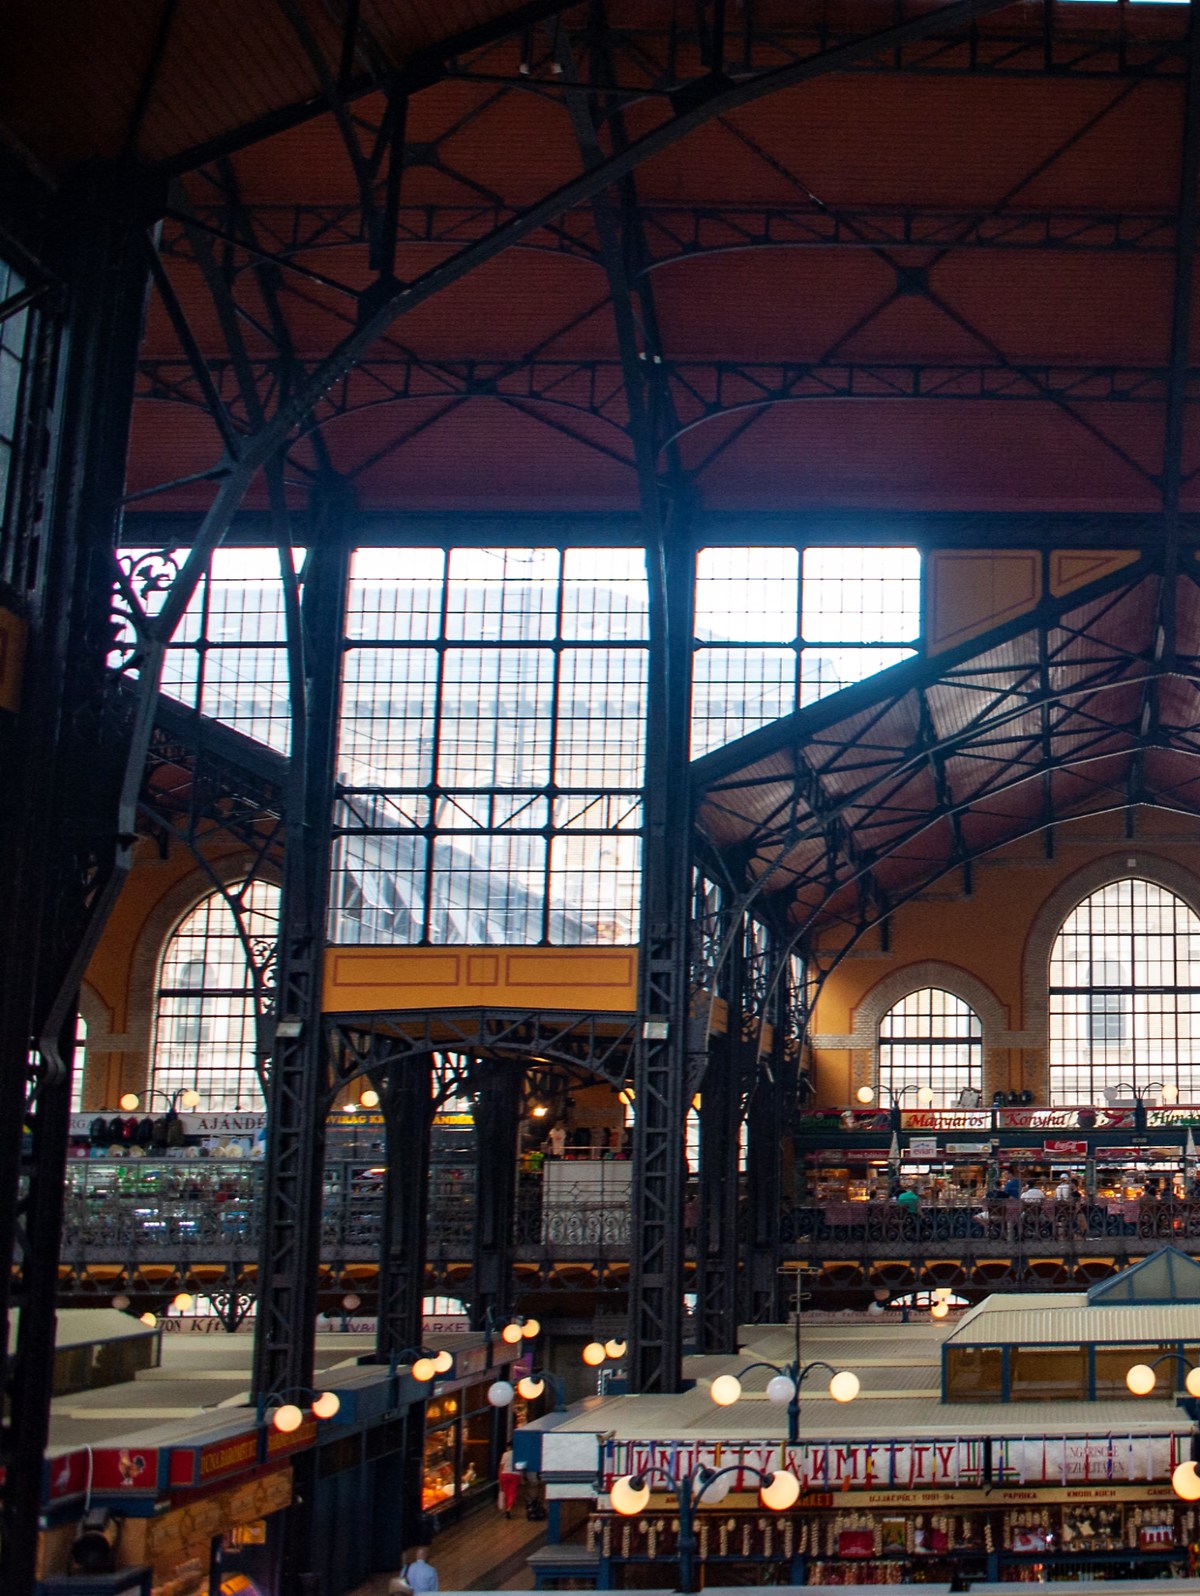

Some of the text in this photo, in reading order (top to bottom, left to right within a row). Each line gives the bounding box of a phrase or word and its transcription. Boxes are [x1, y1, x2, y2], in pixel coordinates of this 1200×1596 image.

[907, 1114, 988, 1131] Magyaros
[1004, 1112, 1067, 1129] Konyha
[811, 1446, 955, 1481] KMETTY
